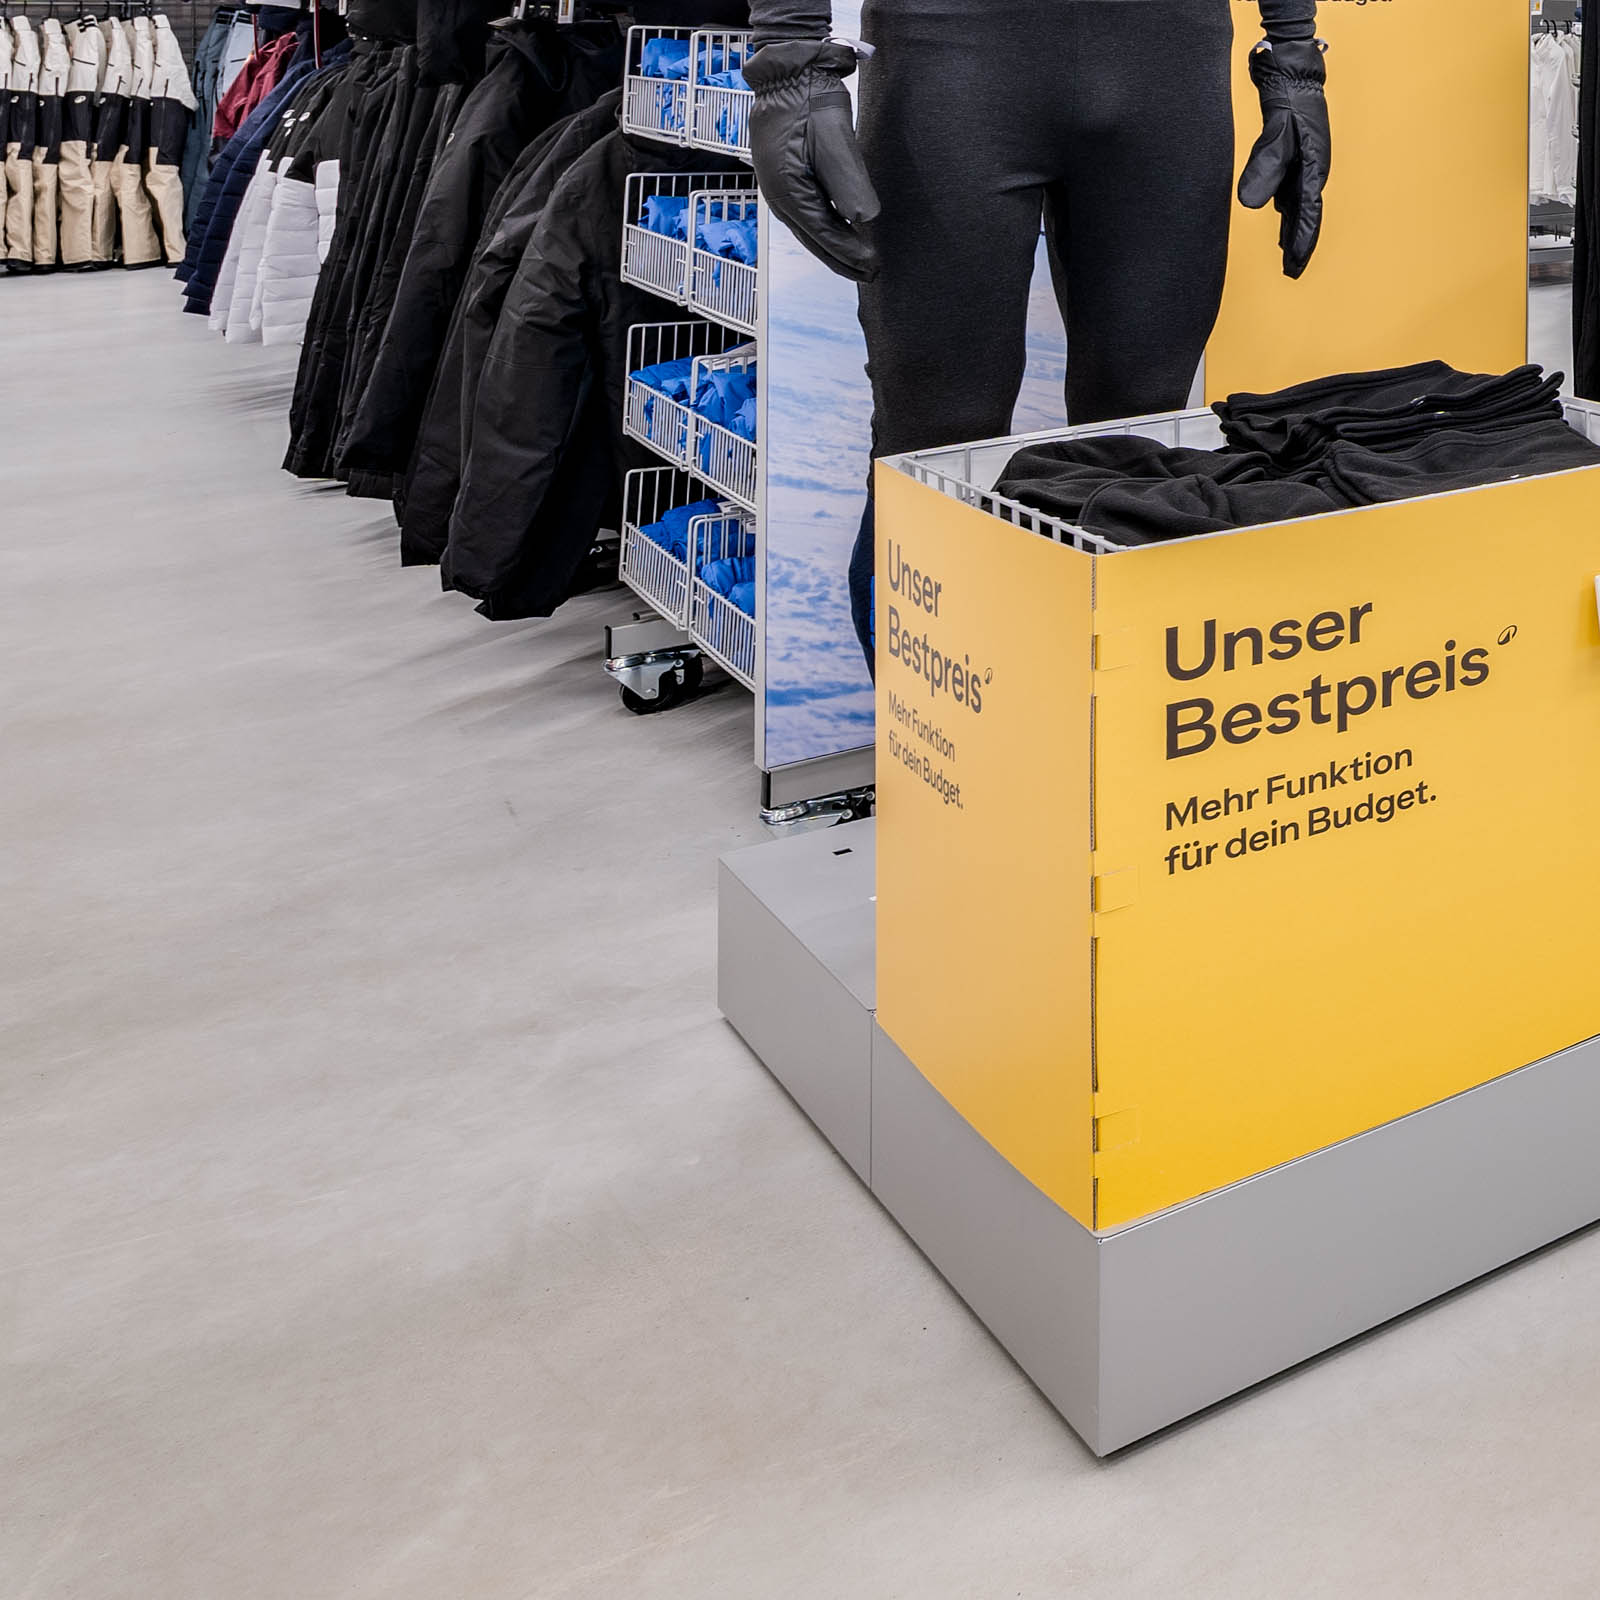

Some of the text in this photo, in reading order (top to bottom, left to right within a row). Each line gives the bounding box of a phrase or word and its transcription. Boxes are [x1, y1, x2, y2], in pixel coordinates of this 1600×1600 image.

[888, 539, 942, 617] Unser
[888, 605, 982, 714] Bestpreis
[1166, 601, 1373, 682] Unser
[888, 690, 955, 763] Mehr Funktion
[1165, 639, 1491, 761] Bestpreis
[888, 729, 964, 810] für dein Budget.
[1165, 746, 1413, 831] Mehr Funktion
[1164, 779, 1437, 876] für dein Budget.
